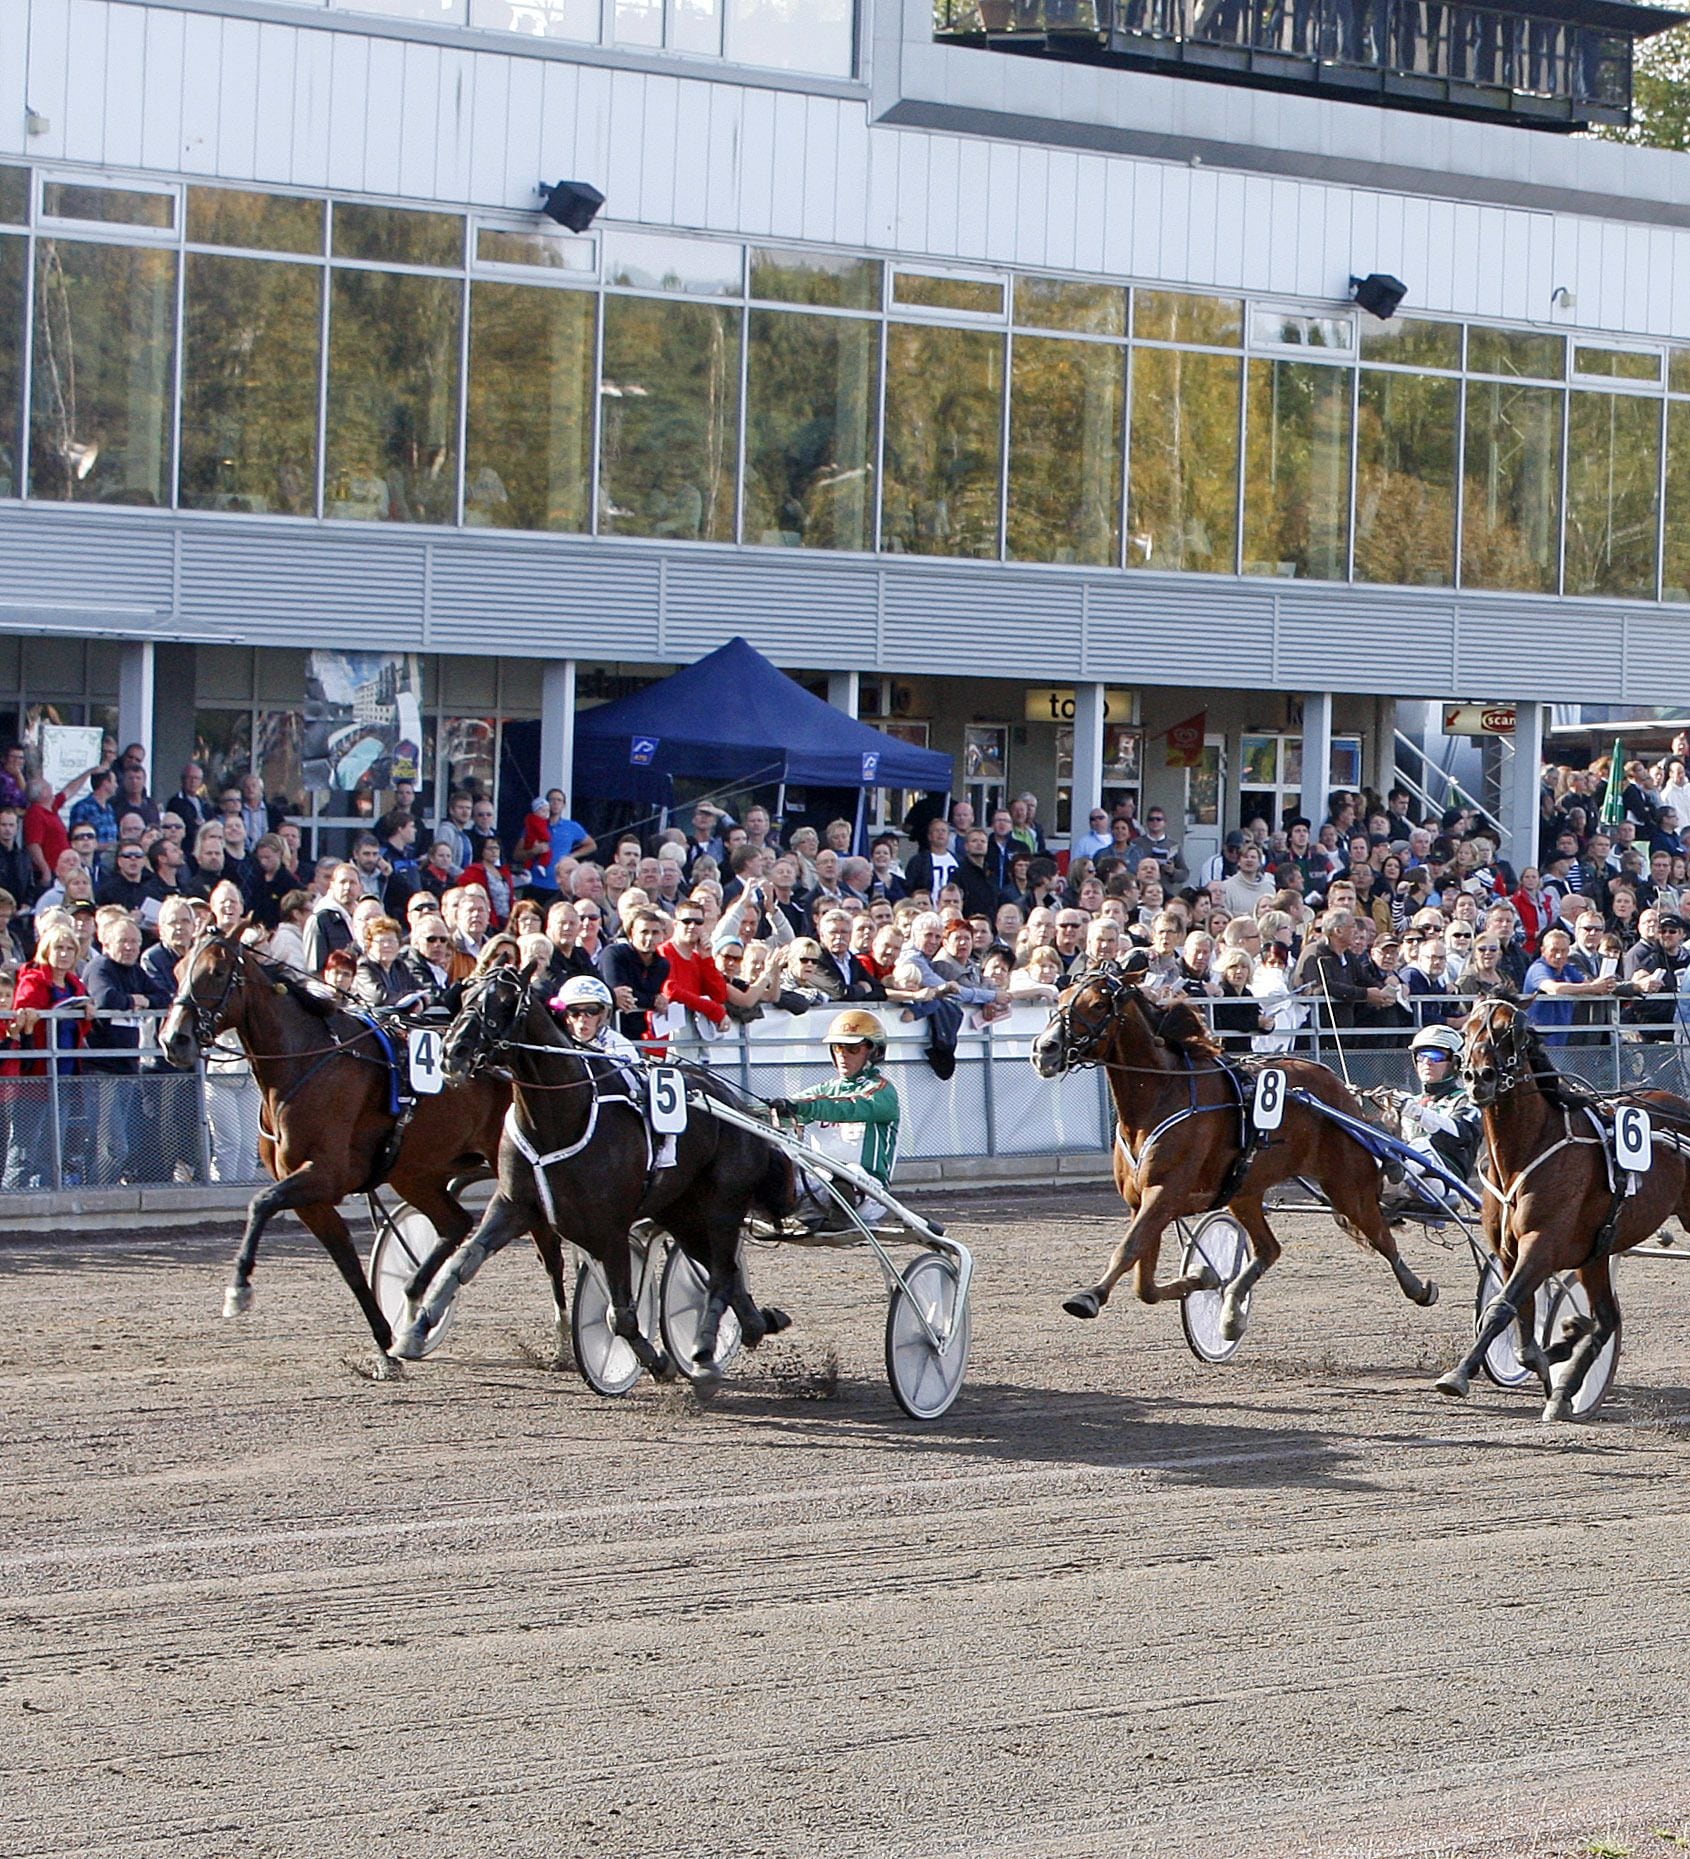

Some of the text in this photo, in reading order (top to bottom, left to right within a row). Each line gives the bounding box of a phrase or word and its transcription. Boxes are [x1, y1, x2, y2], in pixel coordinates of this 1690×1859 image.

[415, 1032, 435, 1075] 4
[656, 1069, 677, 1115] 5
[1261, 1070, 1279, 1112] 8
[1622, 1108, 1642, 1153] 6
